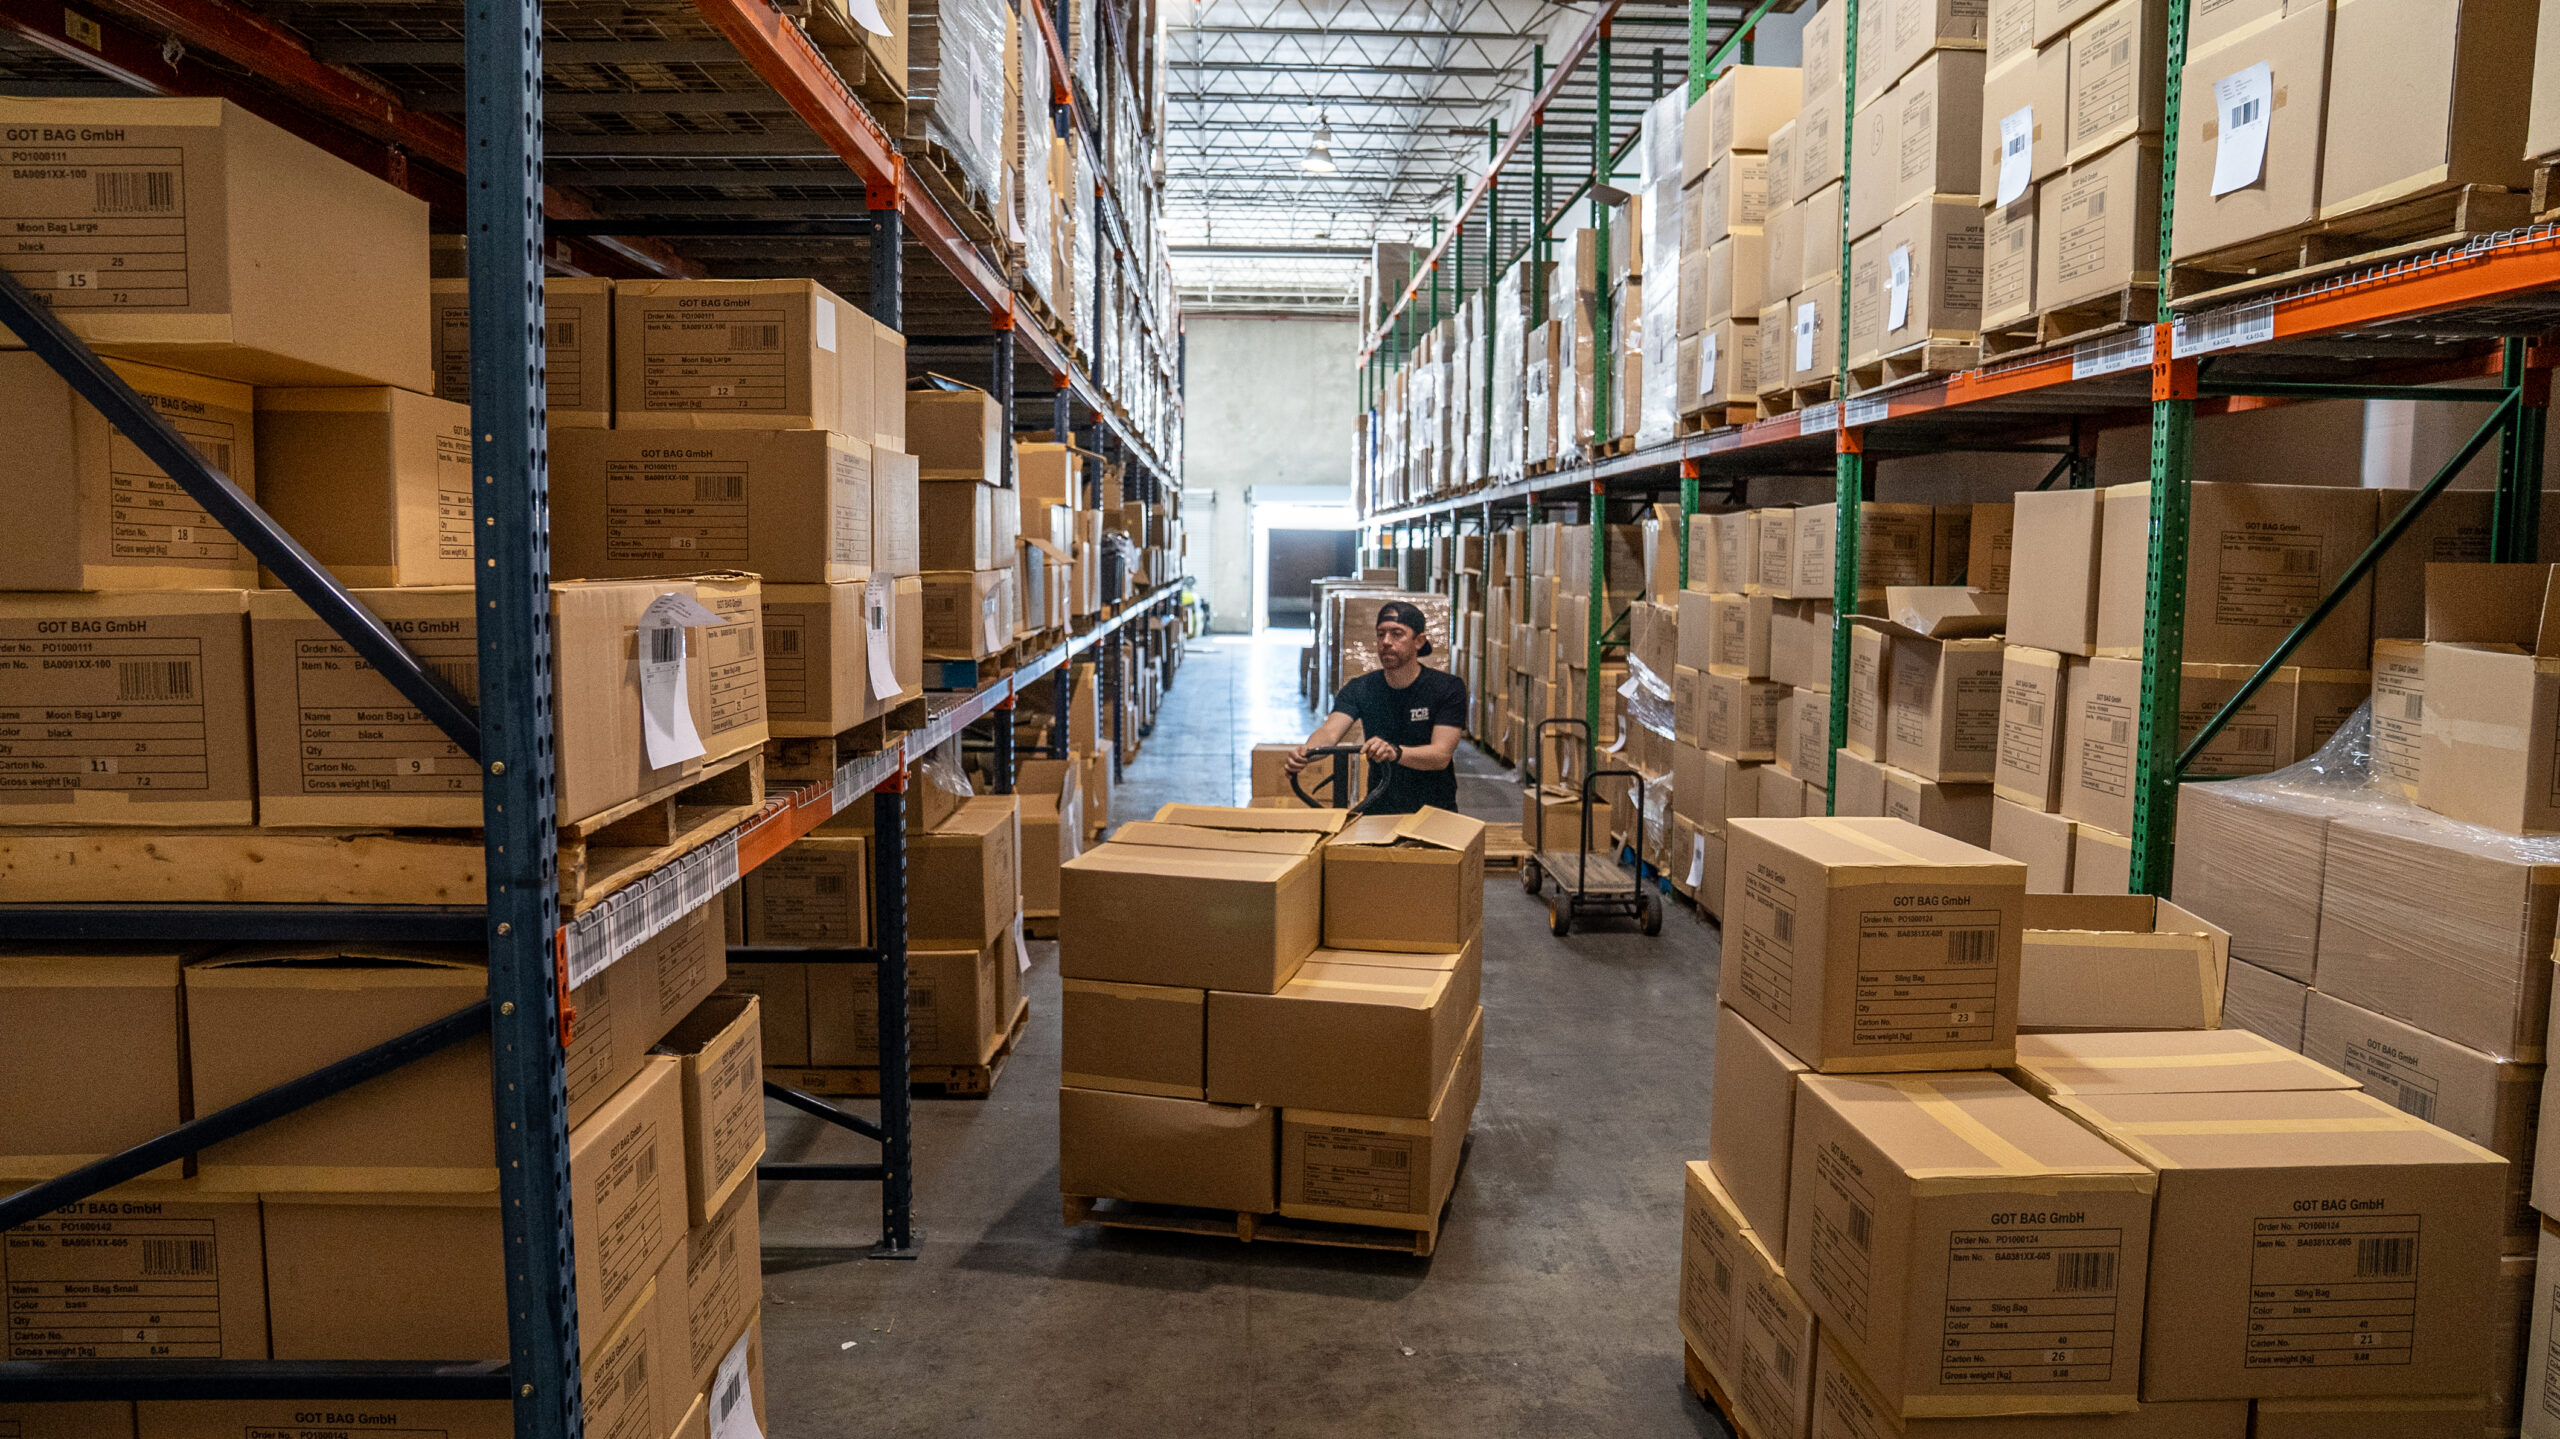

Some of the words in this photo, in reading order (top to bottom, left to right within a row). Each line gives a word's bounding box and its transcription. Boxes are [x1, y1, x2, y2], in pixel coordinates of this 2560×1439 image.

[7, 129, 39, 141] GOT
[44, 129, 76, 141] BAG
[80, 128, 125, 141] GmbH
[16, 222, 45, 232] Moon
[47, 222, 67, 233] Bag
[70, 222, 98, 232] Large
[18, 241, 45, 251] black
[111, 257, 124, 266] 25
[68, 274, 87, 287] 15
[679, 299, 699, 307] GOT
[701, 299, 721, 307] BAG
[723, 299, 750, 307] GmbH
[717, 387, 728, 395] 12
[161, 397, 179, 410] BAG
[641, 449, 661, 458] GOT
[663, 449, 683, 458] BAG
[685, 449, 713, 458] GmbH
[177, 529, 188, 541] 18
[680, 539, 691, 547] 16
[38, 621, 67, 633] GOT
[72, 621, 102, 633] BAG
[106, 621, 147, 632] GmbH
[418, 621, 460, 632] GmbH
[301, 645, 328, 653] Order
[331, 645, 347, 653] No.
[13, 660, 28, 669] No.
[302, 661, 322, 670] Item
[325, 662, 341, 670] No.
[46, 711, 72, 719] Moon
[75, 711, 93, 721] Bag
[96, 710, 122, 720] Large
[304, 712, 331, 720] Name
[357, 712, 384, 720] Moon
[386, 712, 405, 723] Bag
[47, 729, 73, 737] black
[305, 729, 331, 738] Color
[359, 731, 384, 739] black
[135, 743, 147, 752] 25
[306, 746, 322, 756] Qty
[32, 761, 47, 769] No.
[91, 760, 109, 773] 11
[307, 762, 338, 771] Carton
[341, 763, 357, 771] No.
[411, 760, 421, 773] 9
[30, 777, 61, 788] weight
[137, 777, 151, 786] 7.2
[308, 780, 337, 789] Gross
[339, 780, 370, 789] weight
[448, 780, 462, 788] 7.2
[1894, 896, 1914, 906] GOT
[1917, 896, 1939, 905] BAG
[1942, 896, 1970, 905] GmbH
[1912, 974, 1925, 982] Bag
[1958, 1014, 1969, 1022] 23
[2367, 1038, 2381, 1050] GOT
[2382, 1045, 2397, 1057] BAG
[2398, 1051, 2418, 1066] GmbH
[56, 1203, 86, 1214] GOT
[89, 1203, 119, 1214] BAG
[122, 1203, 161, 1214] GmbH
[2293, 1201, 2318, 1211] GOT
[2321, 1200, 2347, 1210] BAG
[2350, 1199, 2384, 1210] GmbH
[1991, 1214, 2017, 1224] GOT
[2020, 1213, 2046, 1223] BAG
[2050, 1212, 2085, 1223] GmbH
[33, 1239, 47, 1247] No.
[12, 1286, 39, 1294] Name
[65, 1285, 90, 1293] Moon
[92, 1285, 111, 1294] Bag
[113, 1284, 138, 1293] Small
[13, 1301, 38, 1309] Color
[2012, 1304, 2028, 1313] Bag
[13, 1316, 30, 1326] Qty
[15, 1332, 46, 1340] Carton
[136, 1330, 145, 1341] 4
[2360, 1335, 2373, 1344] 21
[1947, 1339, 1960, 1347] Qty
[45, 1347, 76, 1357] weight
[2052, 1352, 2066, 1361] 26
[1946, 1355, 1971, 1363] Carton
[1973, 1355, 1986, 1363] No.
[295, 1412, 323, 1423] GOT
[326, 1413, 354, 1423] BAG
[358, 1413, 396, 1424] GmbH
